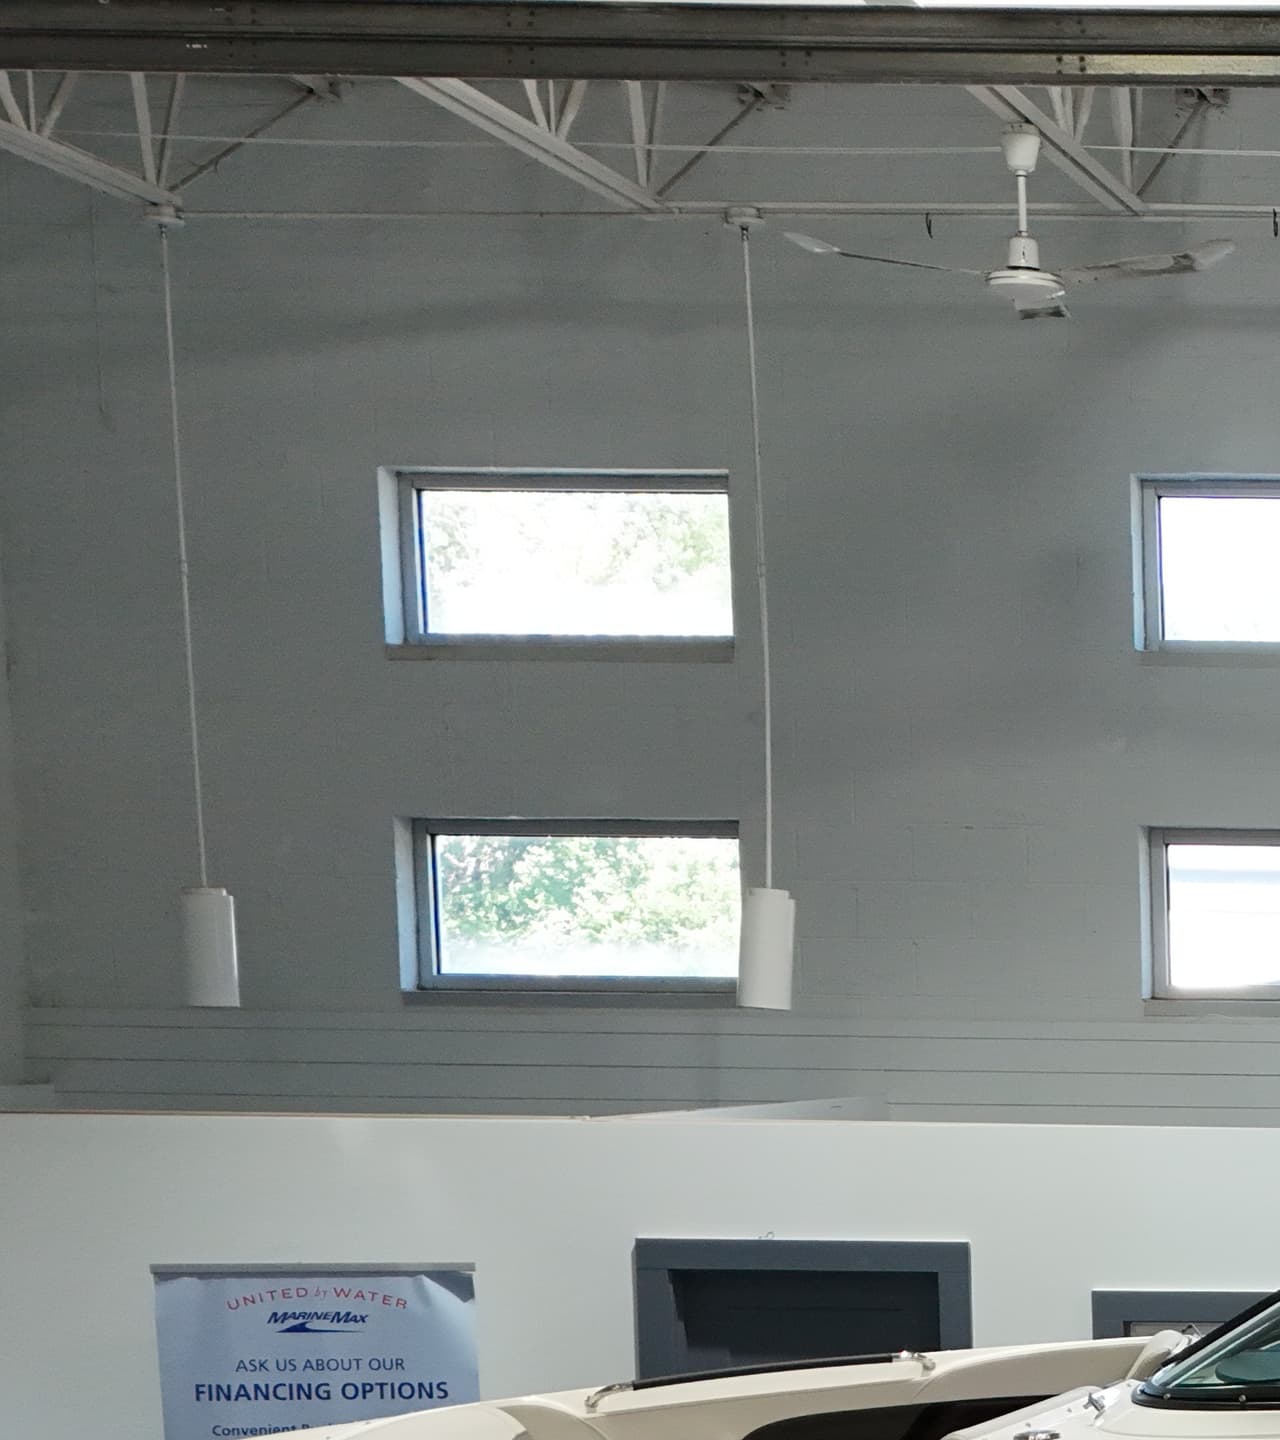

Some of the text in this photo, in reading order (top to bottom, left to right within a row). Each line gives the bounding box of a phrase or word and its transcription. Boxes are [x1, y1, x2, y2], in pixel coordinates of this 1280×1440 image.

[227, 1286, 408, 1311] UNITED by WATER
[235, 1357, 405, 1372] ASK US ABOUT OUR
[195, 1381, 449, 1402] FINANCING OPTIONS
